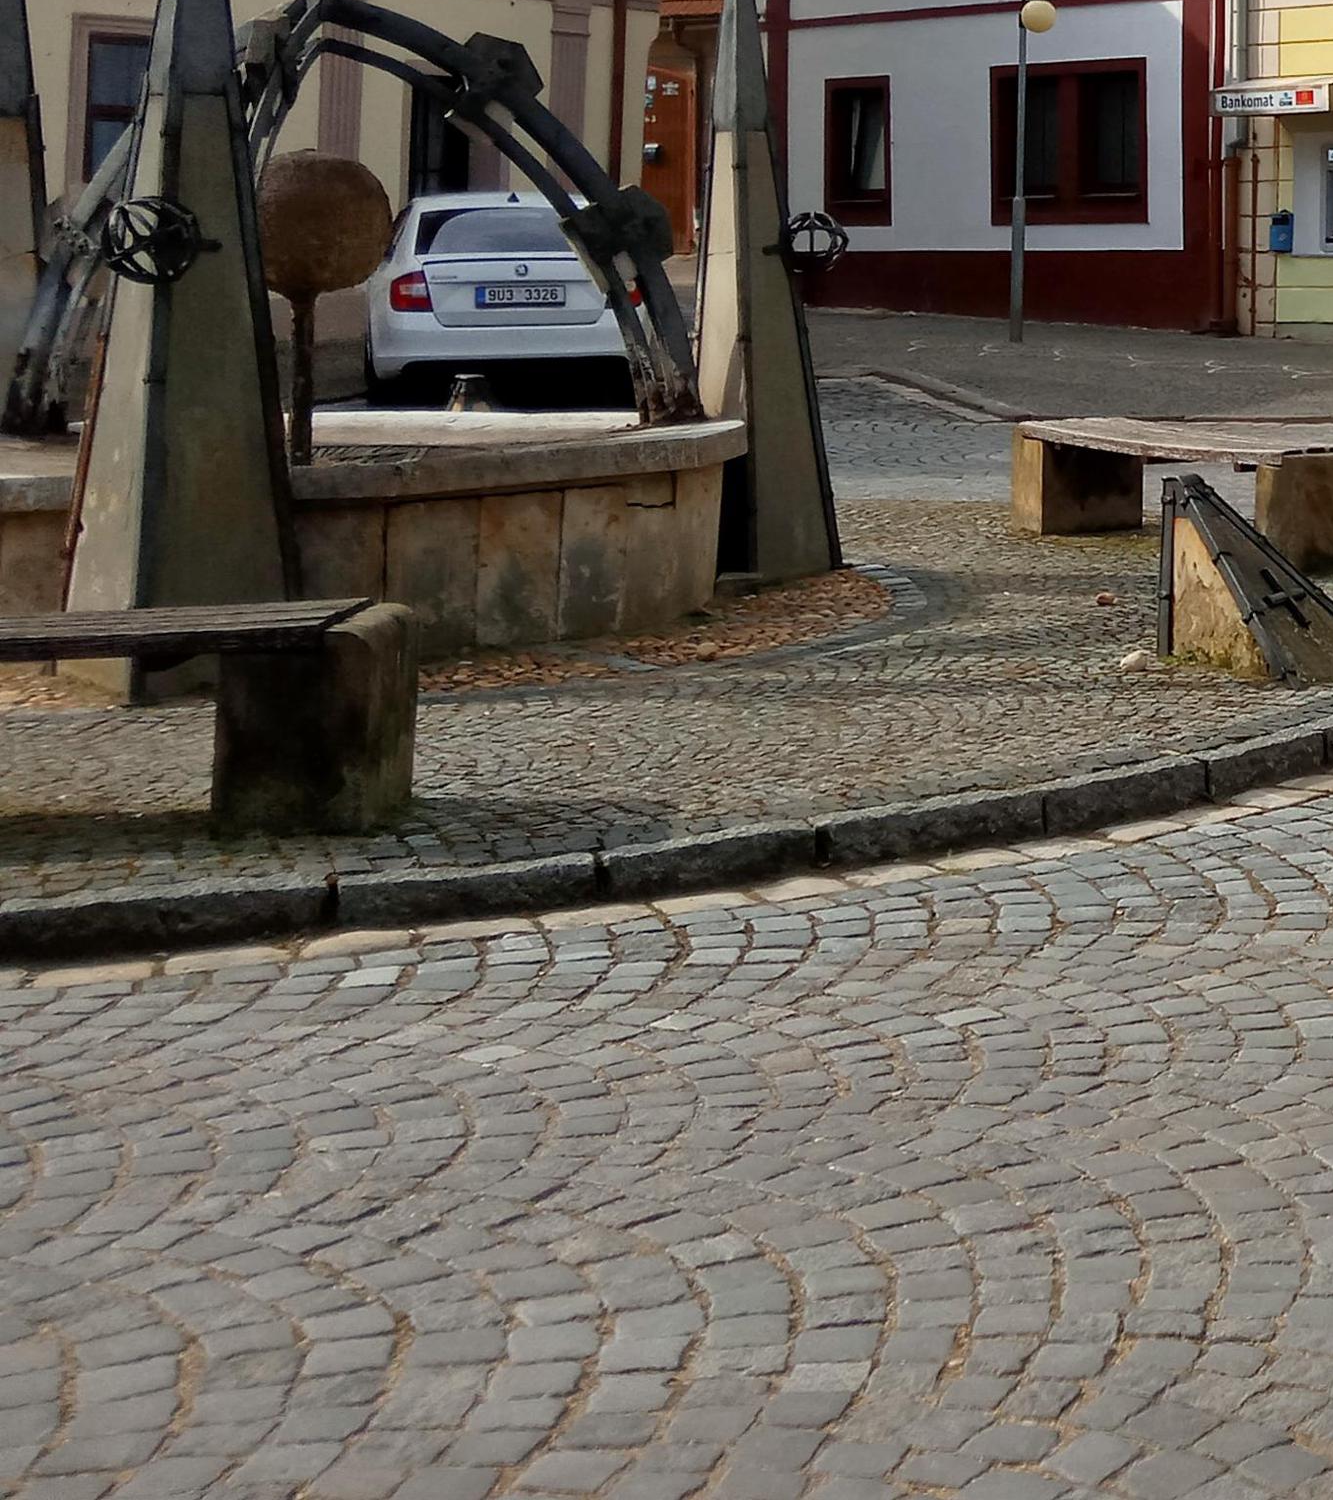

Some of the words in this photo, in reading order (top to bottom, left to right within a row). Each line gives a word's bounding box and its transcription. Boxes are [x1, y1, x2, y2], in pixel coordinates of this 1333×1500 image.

[1221, 94, 1274, 109] Bankomat
[488, 289, 514, 301] 9U3
[524, 288, 559, 301] 3326
